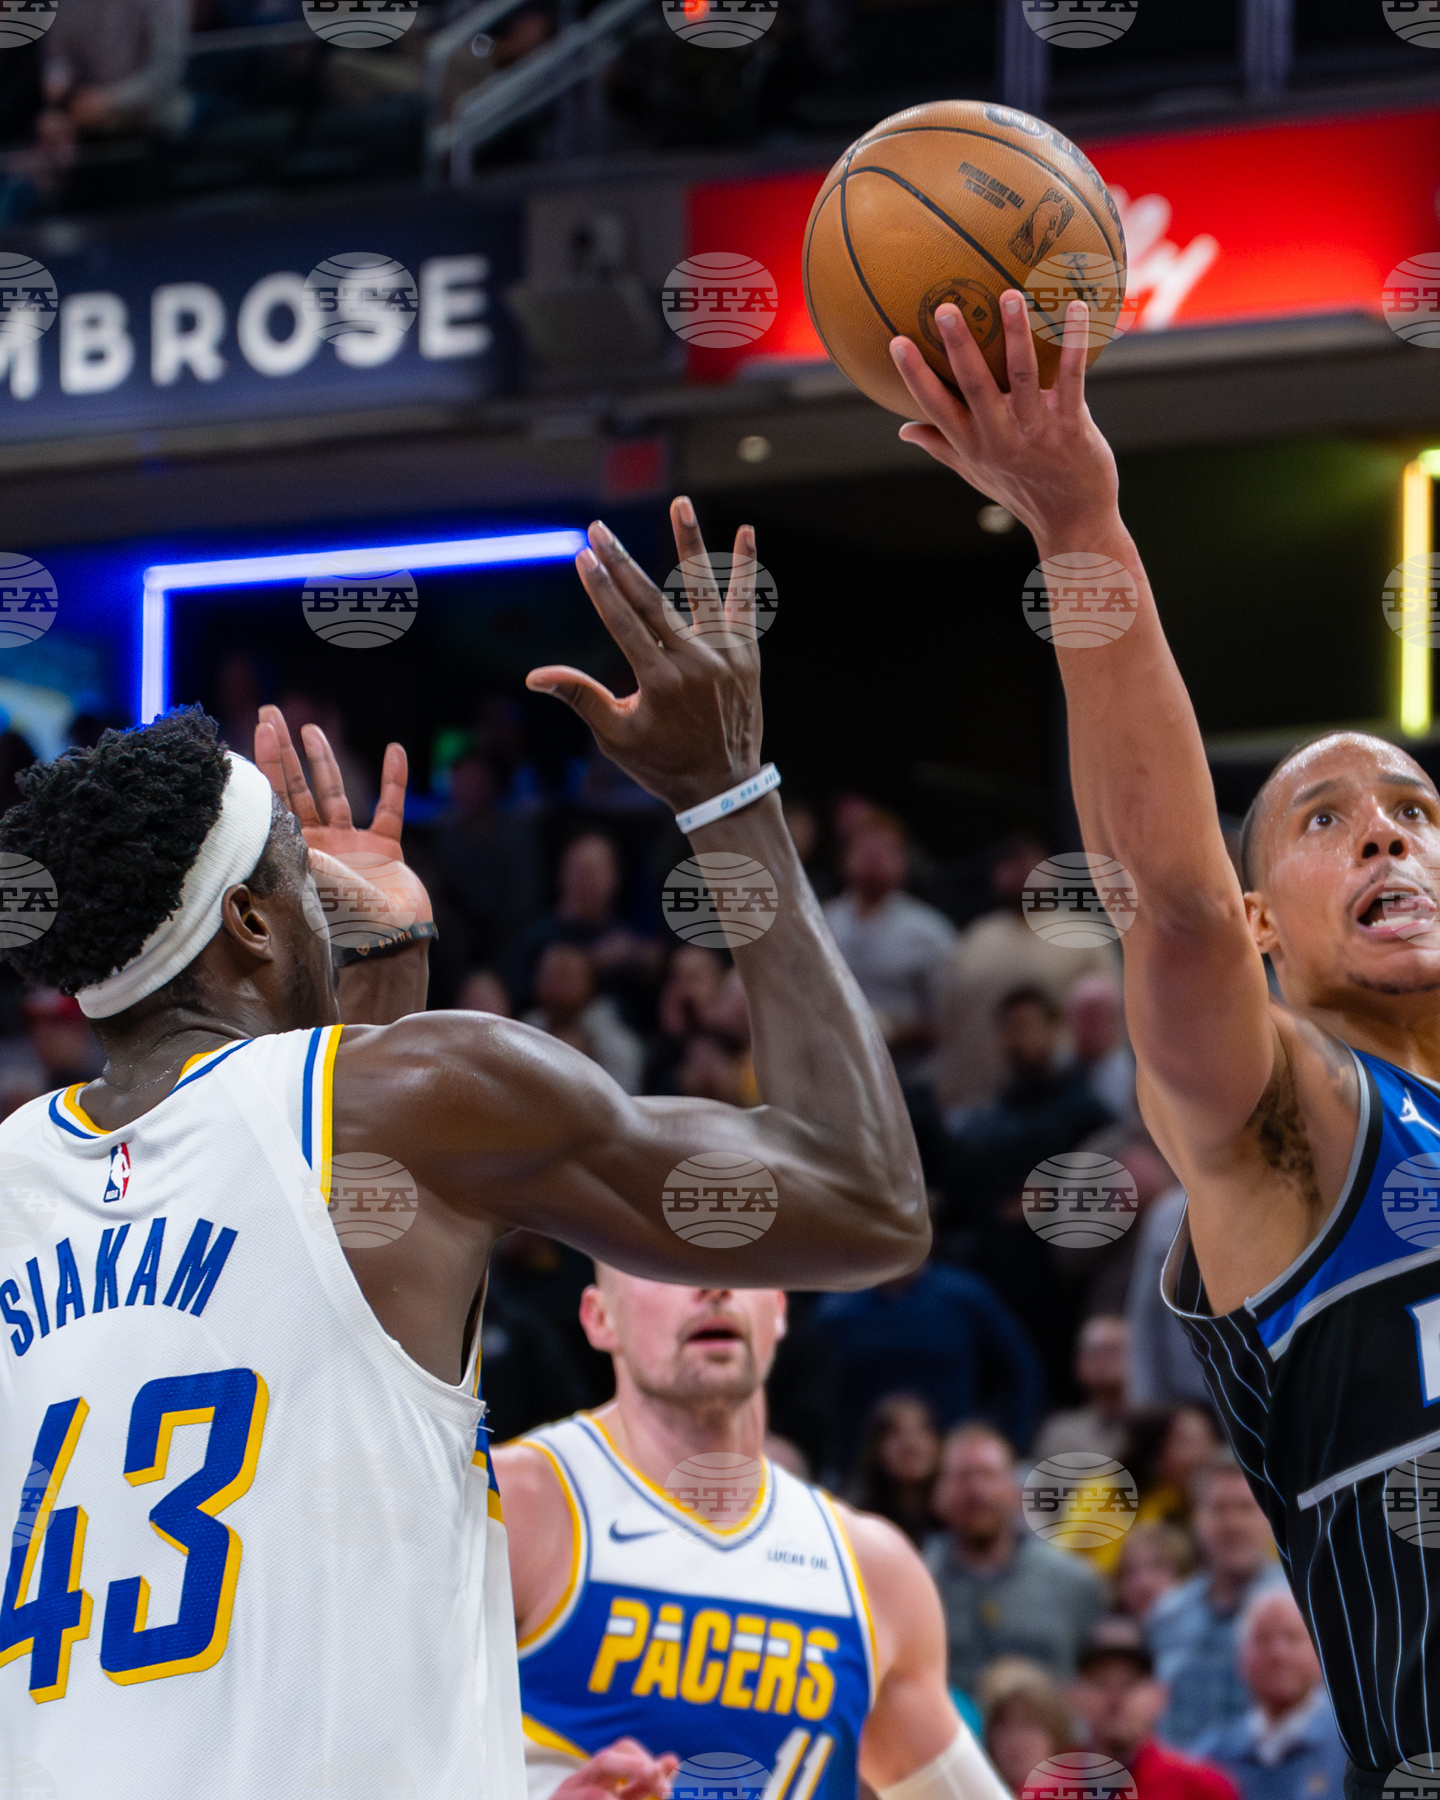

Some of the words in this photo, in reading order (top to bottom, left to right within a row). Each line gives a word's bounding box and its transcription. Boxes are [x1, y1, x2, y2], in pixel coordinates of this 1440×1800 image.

[0, 1217, 238, 1357] SIAKAM
[0, 1368, 269, 1705] 43
[588, 1596, 840, 1722] PACERS
